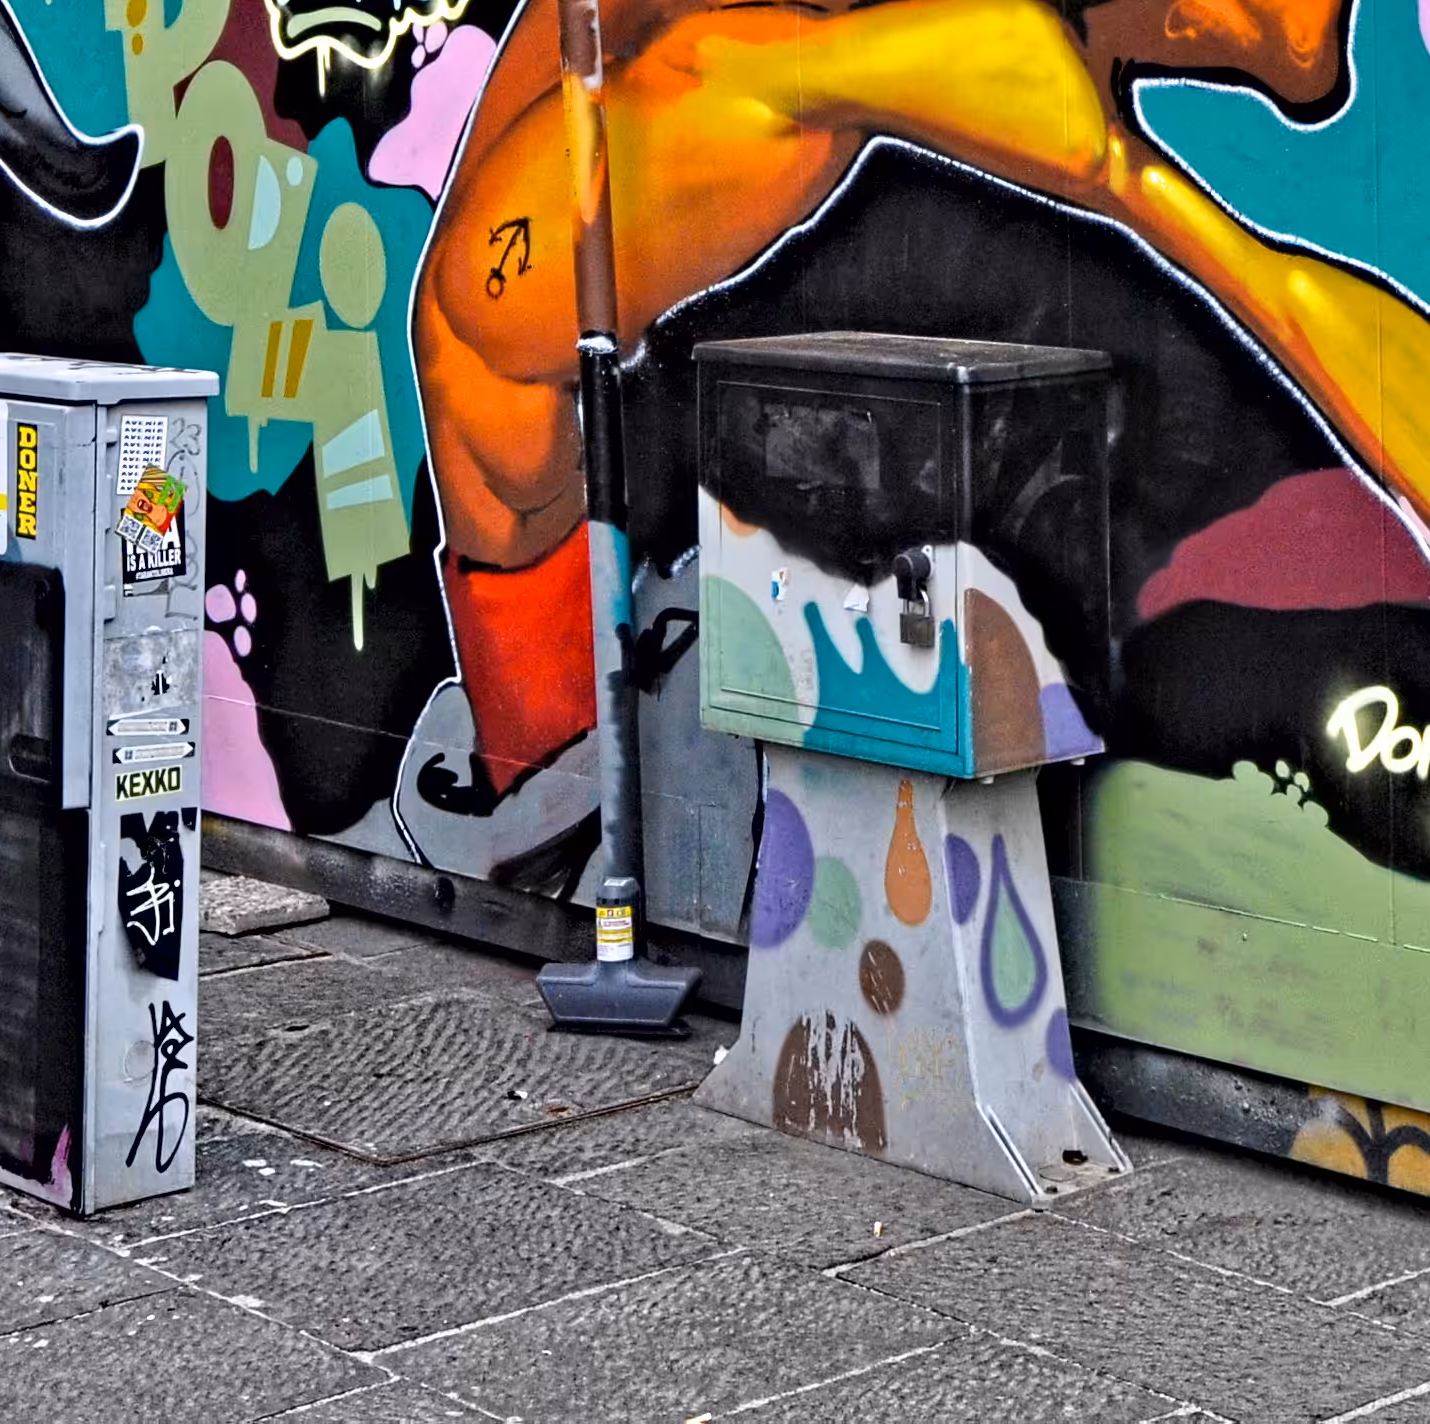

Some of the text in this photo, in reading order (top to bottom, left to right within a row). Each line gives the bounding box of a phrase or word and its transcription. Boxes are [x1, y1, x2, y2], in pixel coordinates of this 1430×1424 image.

[18, 426, 38, 536] DONER
[127, 556, 136, 572] IS
[138, 554, 146, 570] A
